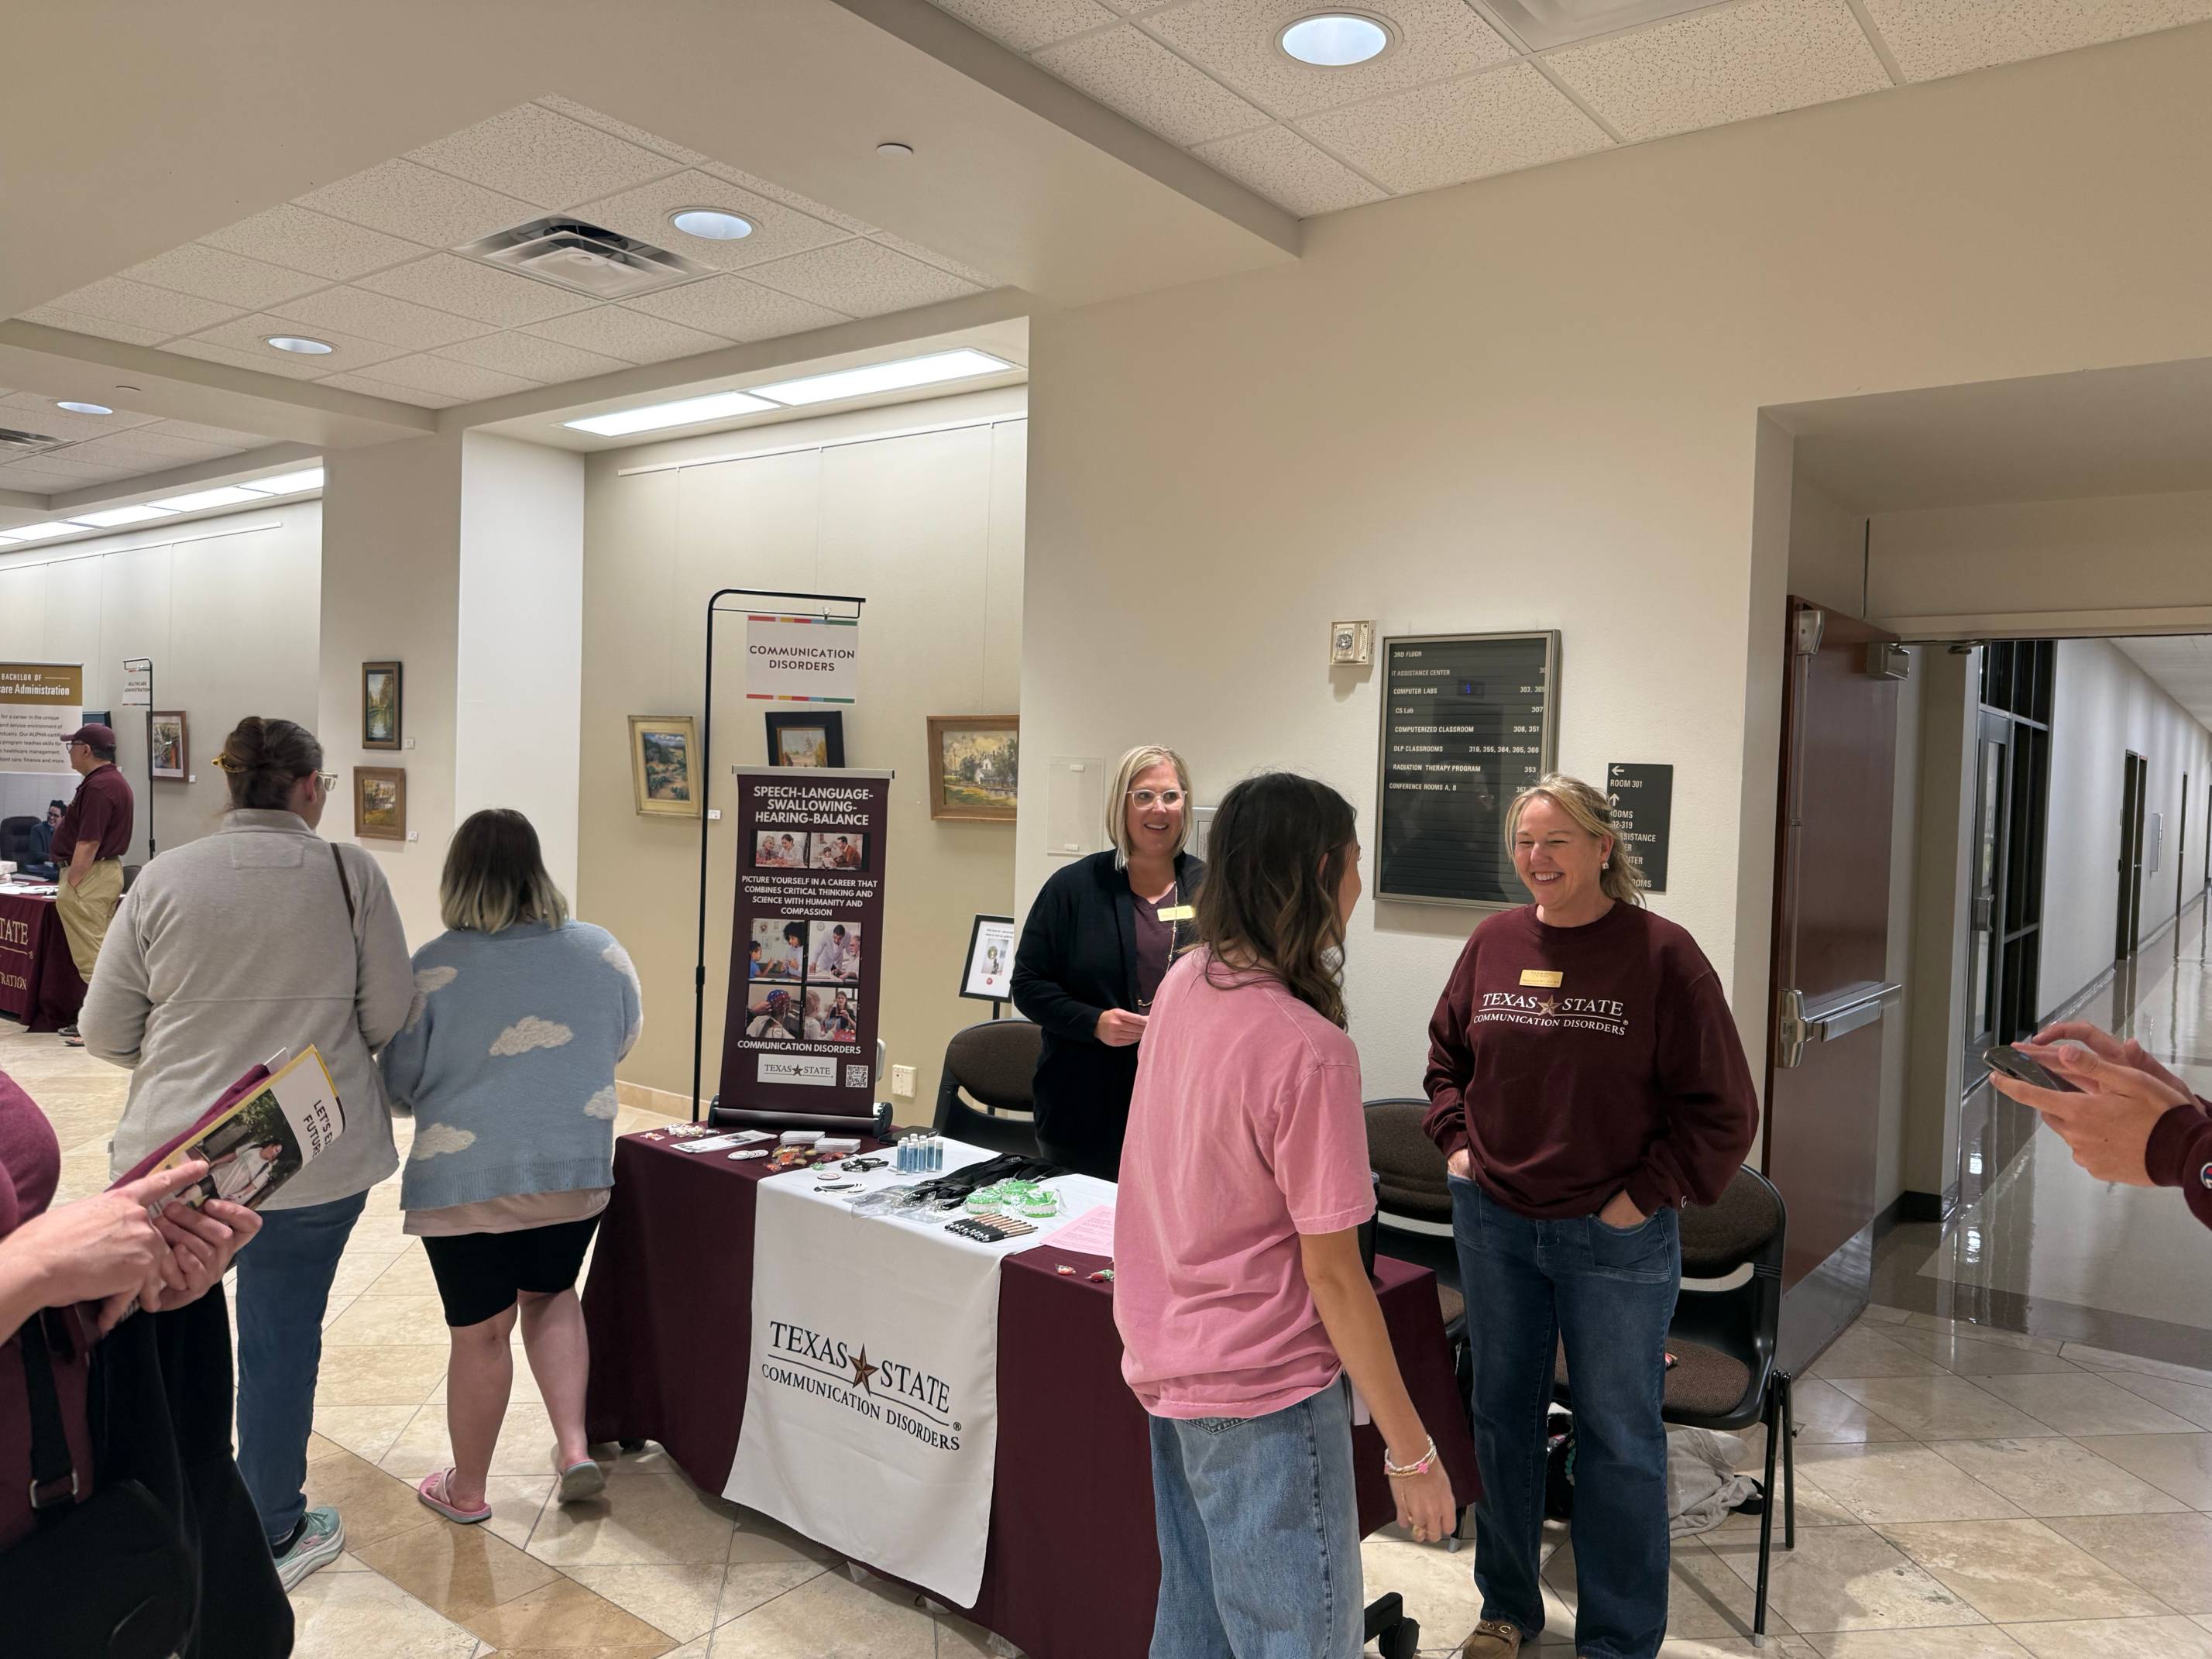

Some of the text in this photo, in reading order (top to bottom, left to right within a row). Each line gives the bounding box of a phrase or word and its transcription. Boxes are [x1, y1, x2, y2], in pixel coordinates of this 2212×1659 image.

[749, 644, 855, 658] COMMUNICATION
[769, 659, 835, 672] DISORDERS
[14, 684, 70, 696] Administration
[1610, 779, 1630, 788] ROOM
[753, 786, 874, 799] SPEECH-LANGUAGE-
[767, 799, 857, 812] SWALLOWING-
[755, 812, 869, 826] HEARING-BALANCE
[741, 875, 770, 884] PICTURE
[771, 877, 810, 885] YOURSELF
[827, 878, 856, 887] CAREER
[744, 885, 782, 894] COMBINES
[783, 887, 817, 895] CRITICAL
[818, 888, 854, 897] THINKING
[752, 895, 782, 904] SCIENCE
[805, 898, 845, 907] HUMANITY
[781, 907, 833, 916] COMPASSION
[0, 917, 29, 946] TATE
[1482, 992, 1624, 1016] TEXAS STATE
[1473, 1013, 1561, 1027] COMMUNICATION
[1563, 1018, 1626, 1036] DISORDERS
[737, 1040, 861, 1054] COMMUNICATION DISORDERS
[764, 1063, 831, 1075] TEXAS STATE
[314, 1099, 331, 1132] LET'S
[770, 1321, 950, 1413] TEXAS STATE
[761, 1363, 881, 1420] COMMUNICATION
[886, 1408, 960, 1451] DISORDERS
